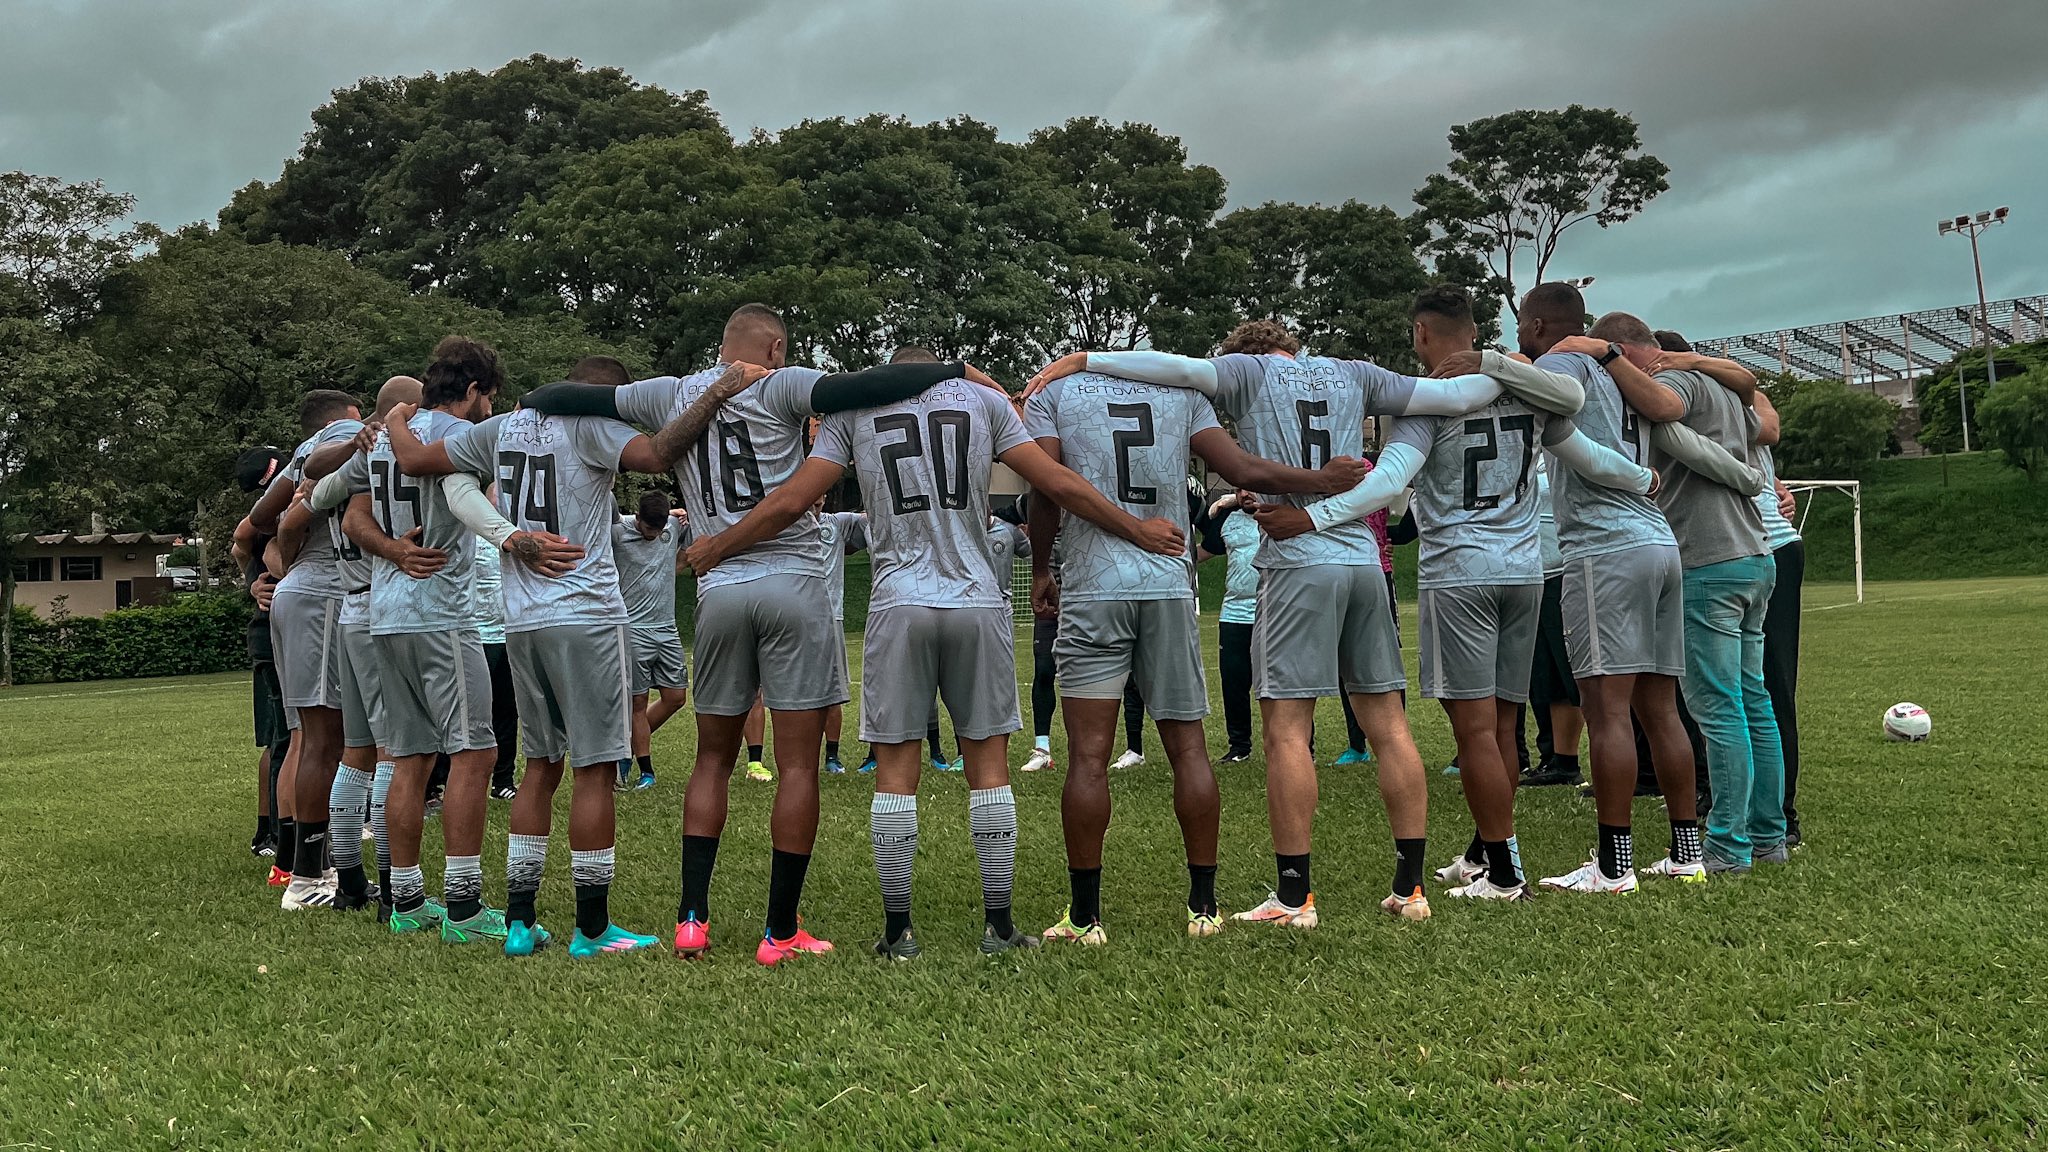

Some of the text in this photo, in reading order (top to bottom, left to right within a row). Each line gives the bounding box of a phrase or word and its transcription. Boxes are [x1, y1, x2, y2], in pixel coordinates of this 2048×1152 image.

[697, 419, 766, 517] 18
[873, 409, 971, 516] 20
[1106, 402, 1156, 505] 2
[1296, 400, 1332, 470] 6
[1463, 414, 1535, 511] 27
